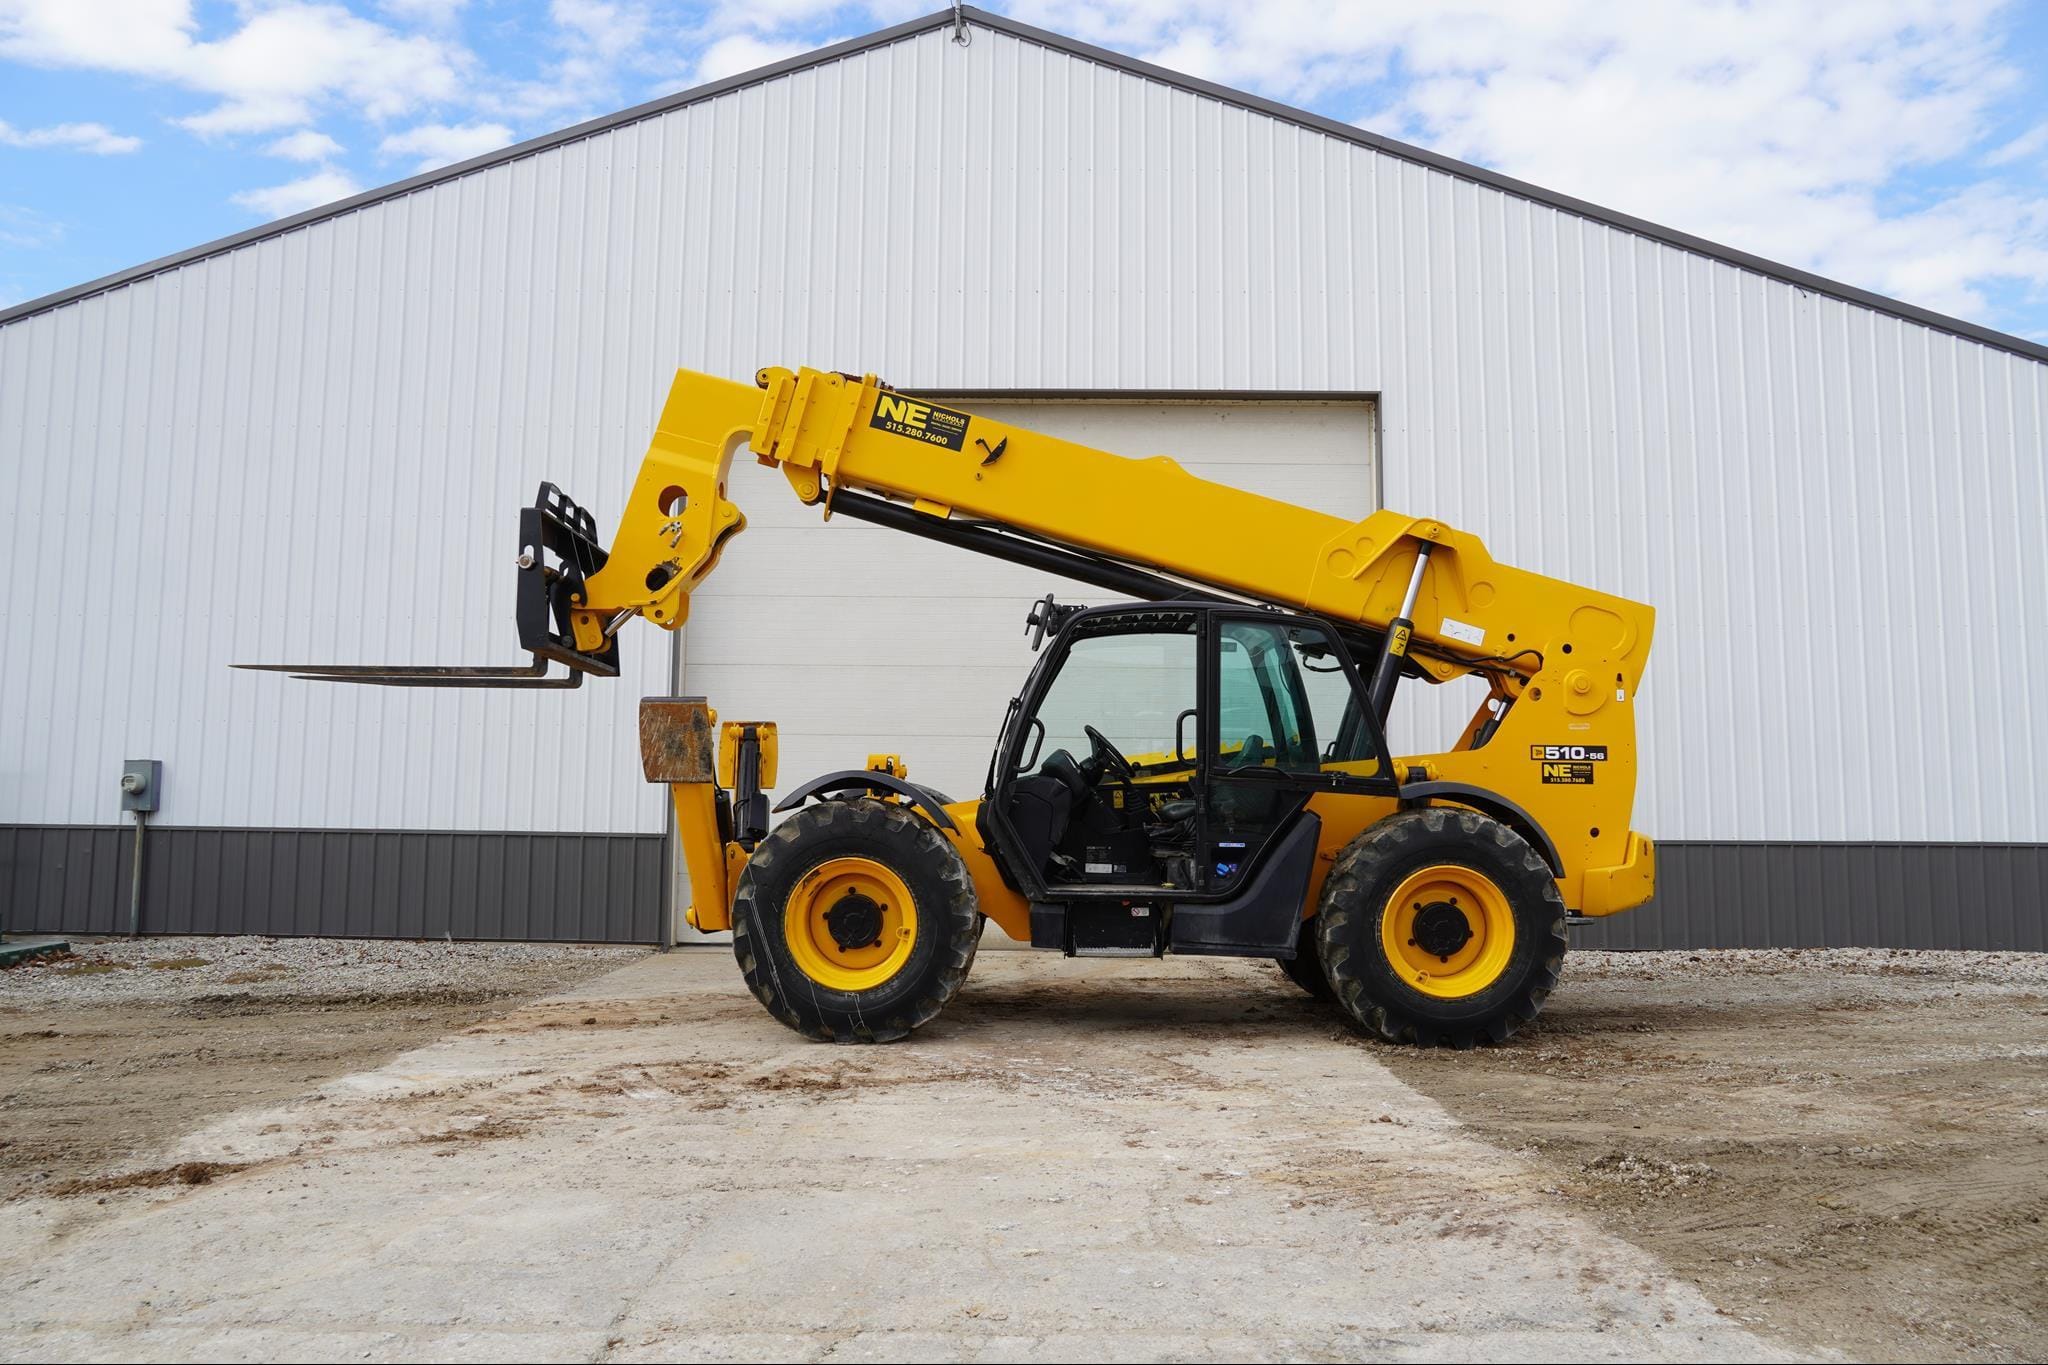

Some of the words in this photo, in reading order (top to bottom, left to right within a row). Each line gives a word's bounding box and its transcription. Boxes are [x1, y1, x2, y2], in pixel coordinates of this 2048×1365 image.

[877, 396, 931, 429] NE
[933, 411, 965, 424] NICHOLS
[885, 421, 948, 445] 515.280.7600
[1543, 764, 1572, 777] NE
